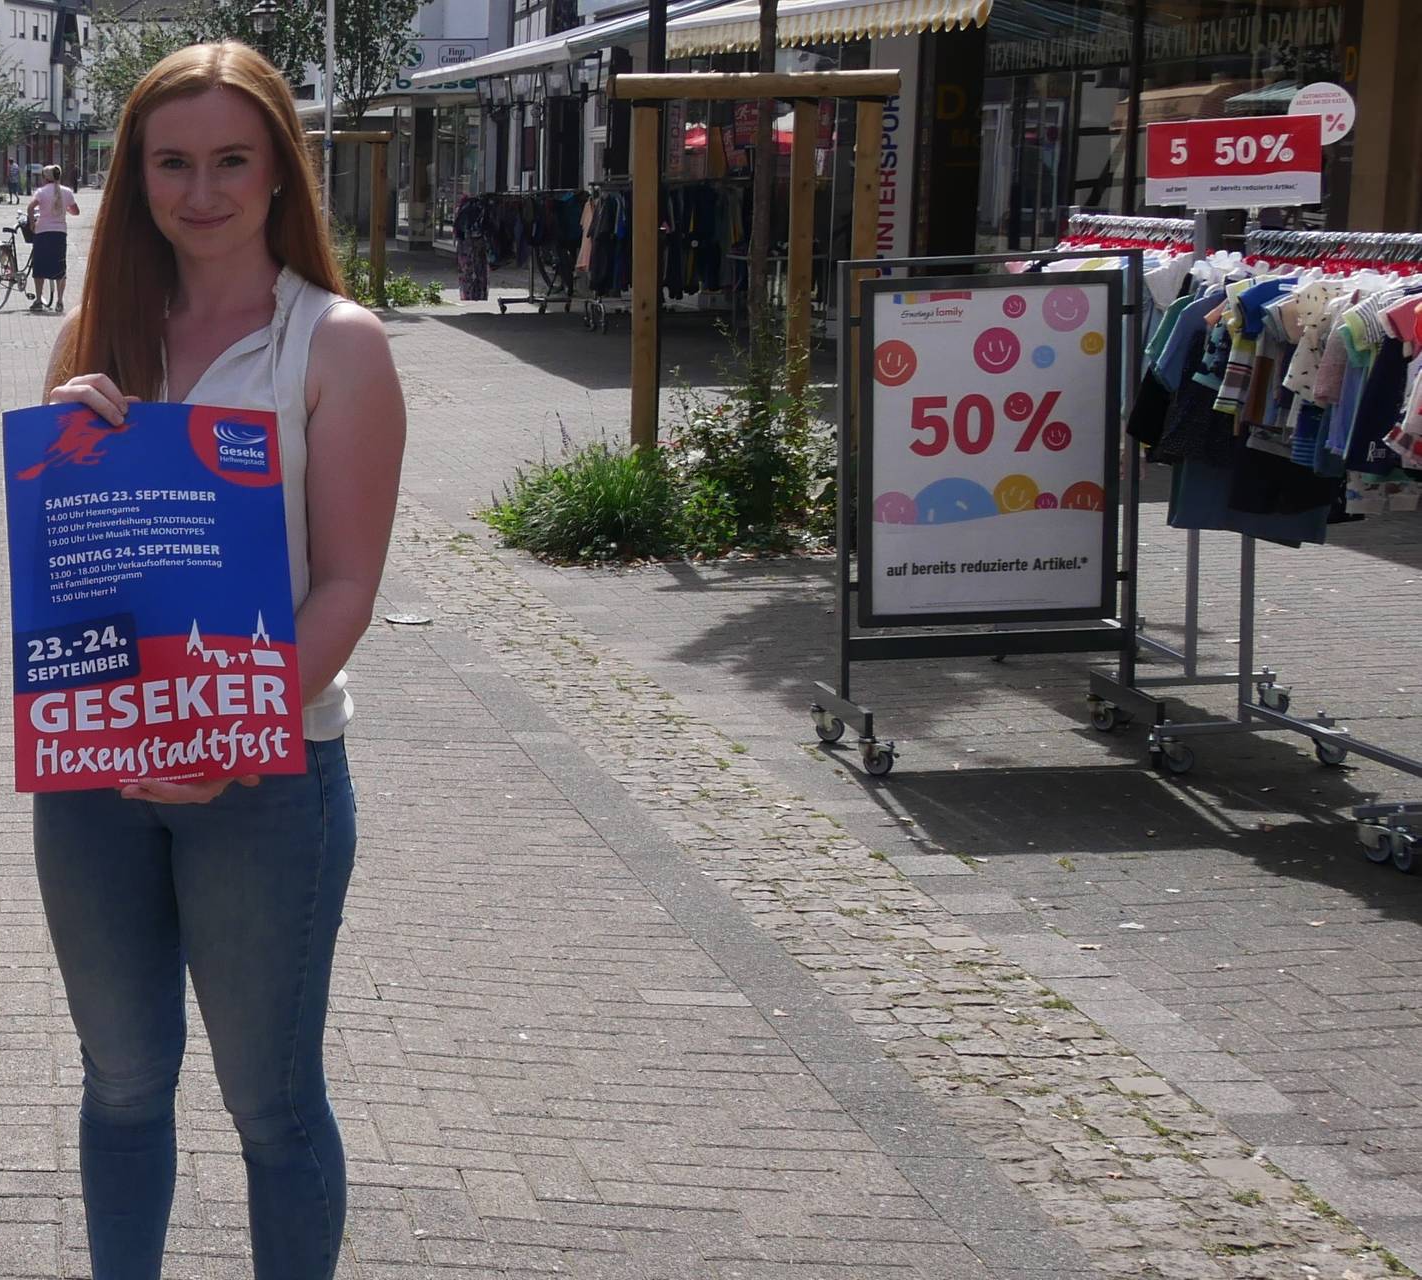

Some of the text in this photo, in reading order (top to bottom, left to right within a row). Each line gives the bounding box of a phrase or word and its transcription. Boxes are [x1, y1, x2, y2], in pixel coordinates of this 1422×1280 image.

[1143, 18, 1222, 59] TEXTILIEN
[1268, 7, 1342, 49] DAMEN
[1215, 134, 1295, 165] 50%
[877, 95, 899, 250] INTERSPOR
[936, 307, 963, 317] family
[909, 391, 1072, 457] 50%
[219, 446, 264, 458] Geseke
[220, 456, 265, 465] Hellwegstadt
[45, 490, 216, 510] SAMSTAG 23. SEPTEMBER
[46, 506, 140, 523] 14.00 Uhr Hexengames
[47, 527, 68, 535] 17.00
[70, 524, 85, 532] Uhr
[87, 518, 151, 529] Preisverleihung
[48, 528, 205, 547] 19.00 Uhr Live Musik THE MONOTYPES
[49, 544, 220, 568] SONNTAG 24. SEPTEMBER
[50, 570, 71, 580] 13.00
[78, 566, 99, 576] 18.00
[101, 564, 116, 572] Uhr
[118, 559, 185, 570] Verkaufsoffener
[186, 558, 222, 568] Sonntag
[887, 563, 908, 577] auf
[911, 558, 956, 575] bereits
[961, 557, 1028, 573] reduzierte
[50, 572, 142, 590] mit Familienprogramm
[51, 594, 73, 603] 15.00
[74, 591, 89, 600] Uhr
[91, 589, 108, 597] Herr
[27, 625, 128, 663] 23.-24.
[27, 652, 130, 682] SEPTEMBER
[30, 674, 288, 733] GESEKER
[36, 721, 290, 777] Hexenstadtfest
